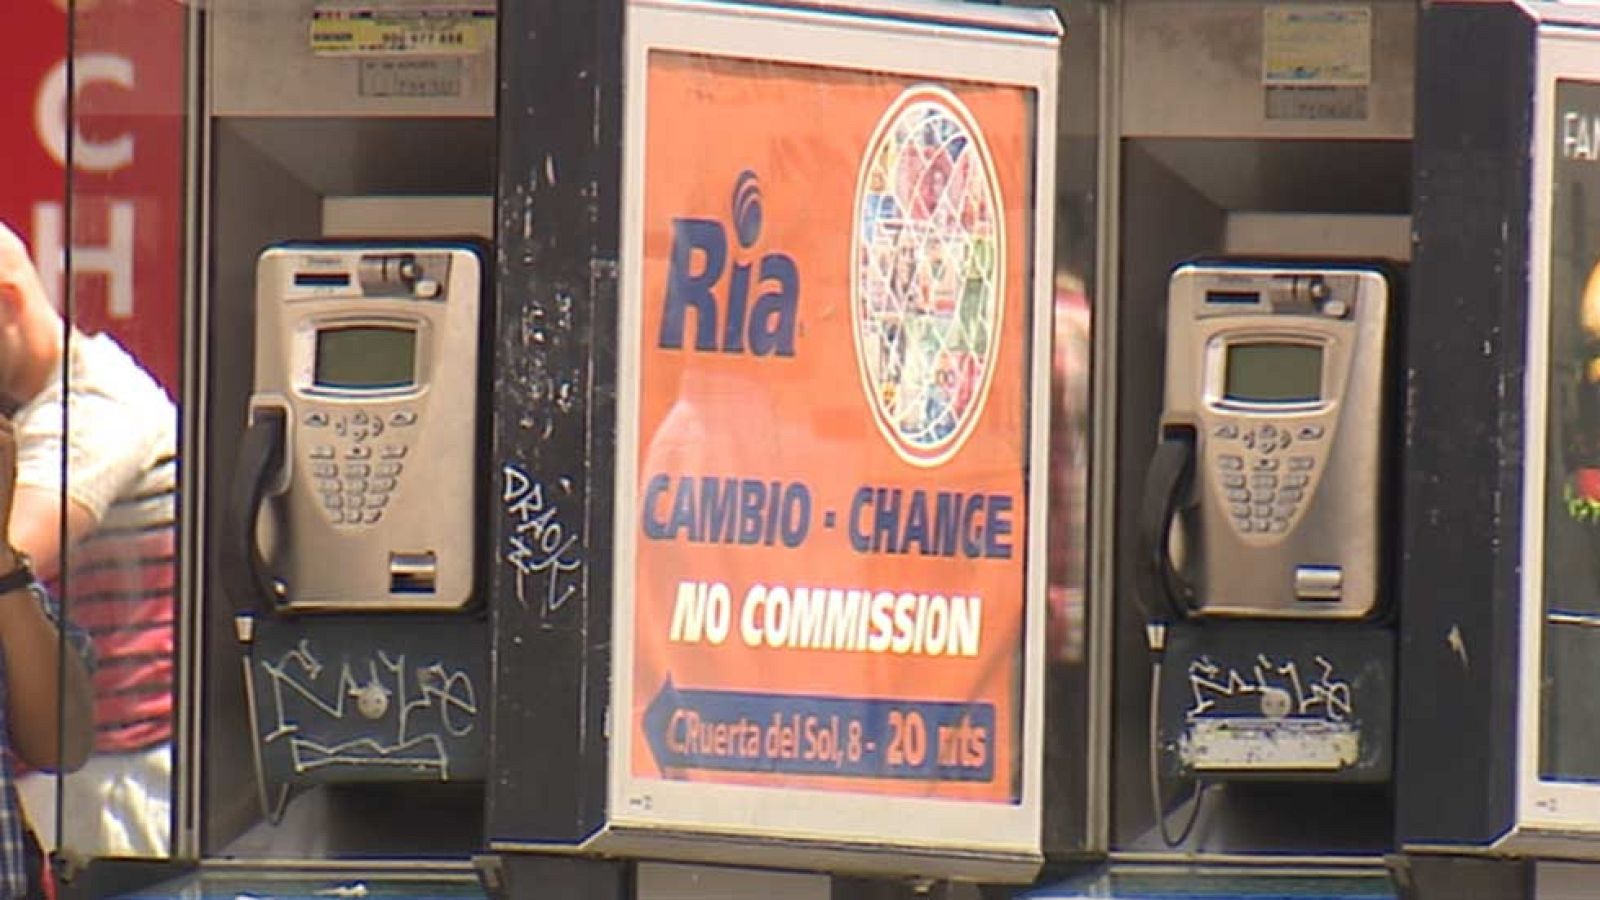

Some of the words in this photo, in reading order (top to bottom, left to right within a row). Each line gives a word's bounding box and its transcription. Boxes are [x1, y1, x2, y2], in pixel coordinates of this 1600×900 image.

[657, 169, 799, 357] Ria
[642, 474, 811, 547] CAMBIO
[848, 486, 1013, 559] CHANGE
[670, 582, 731, 644] NO
[740, 584, 981, 656] COMMISSION
[766, 712, 800, 759] del
[804, 715, 842, 768] Sol,
[886, 710, 926, 767] 20
